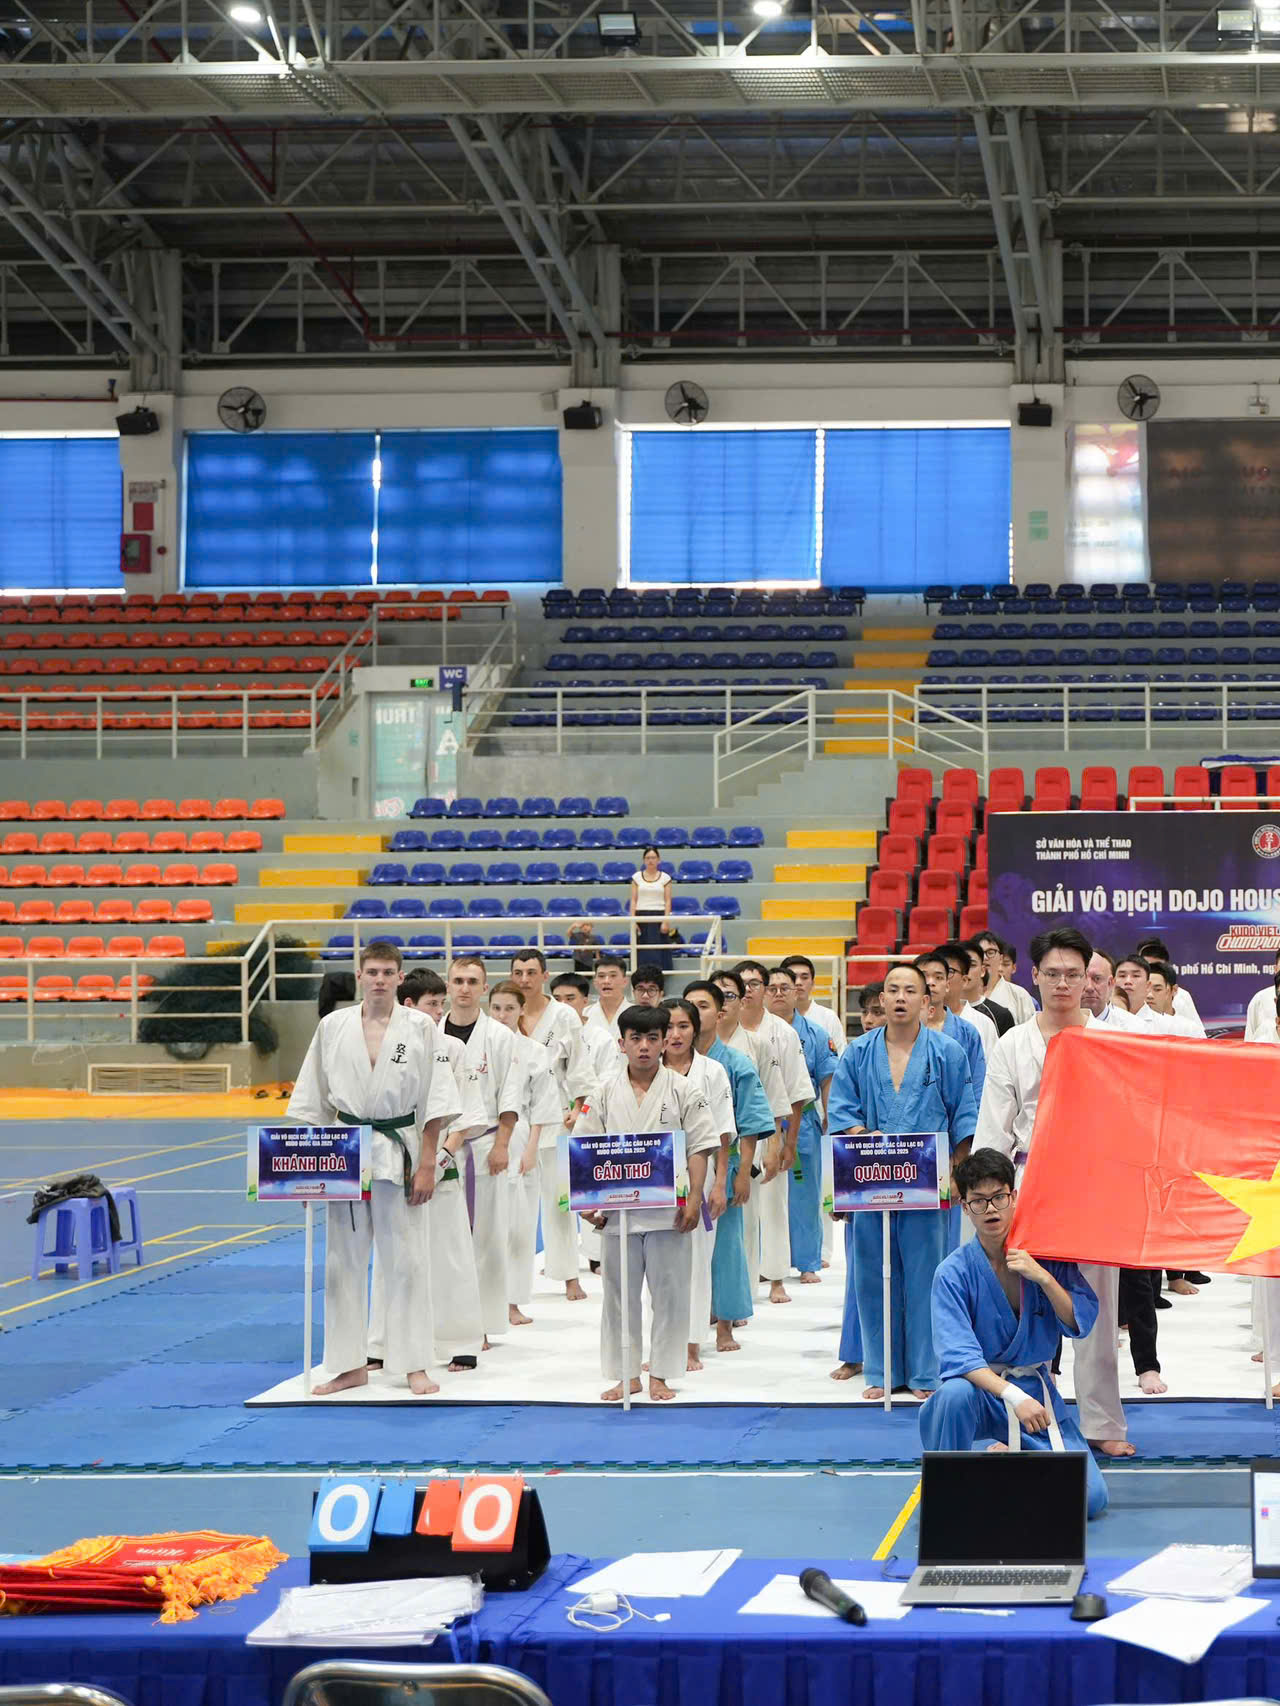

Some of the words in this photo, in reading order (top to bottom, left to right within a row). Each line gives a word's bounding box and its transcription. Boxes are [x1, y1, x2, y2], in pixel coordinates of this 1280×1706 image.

[443, 669, 463, 679] WC
[1036, 838, 1047, 848] SỞ
[1048, 838, 1064, 848] VĂN
[1083, 838, 1095, 848] VÀ
[1095, 836, 1110, 848] THỂ
[1112, 839, 1131, 848] THAO
[1036, 850, 1062, 860] THÀNH
[1063, 848, 1080, 860] PHỐ
[1093, 849, 1107, 860] CHÍ
[1108, 851, 1130, 860] MINH
[1032, 883, 1074, 912] GIẢI
[1080, 885, 1107, 912] VÔ
[1113, 889, 1163, 916] ĐỊCH
[1169, 889, 1223, 912] DOJO
[1181, 962, 1200, 976] phố
[1215, 963, 1231, 974] Chí
[1233, 963, 1260, 975] Minh,
[272, 1153, 317, 1172] KHÁNH
[319, 1153, 347, 1172] HÒA
[624, 1161, 651, 1180] THƠ
[854, 1163, 891, 1183] QUÂN
[893, 1162, 917, 1183] ĐỘI
[318, 1484, 370, 1542] 0
[460, 1484, 513, 1542] 0
